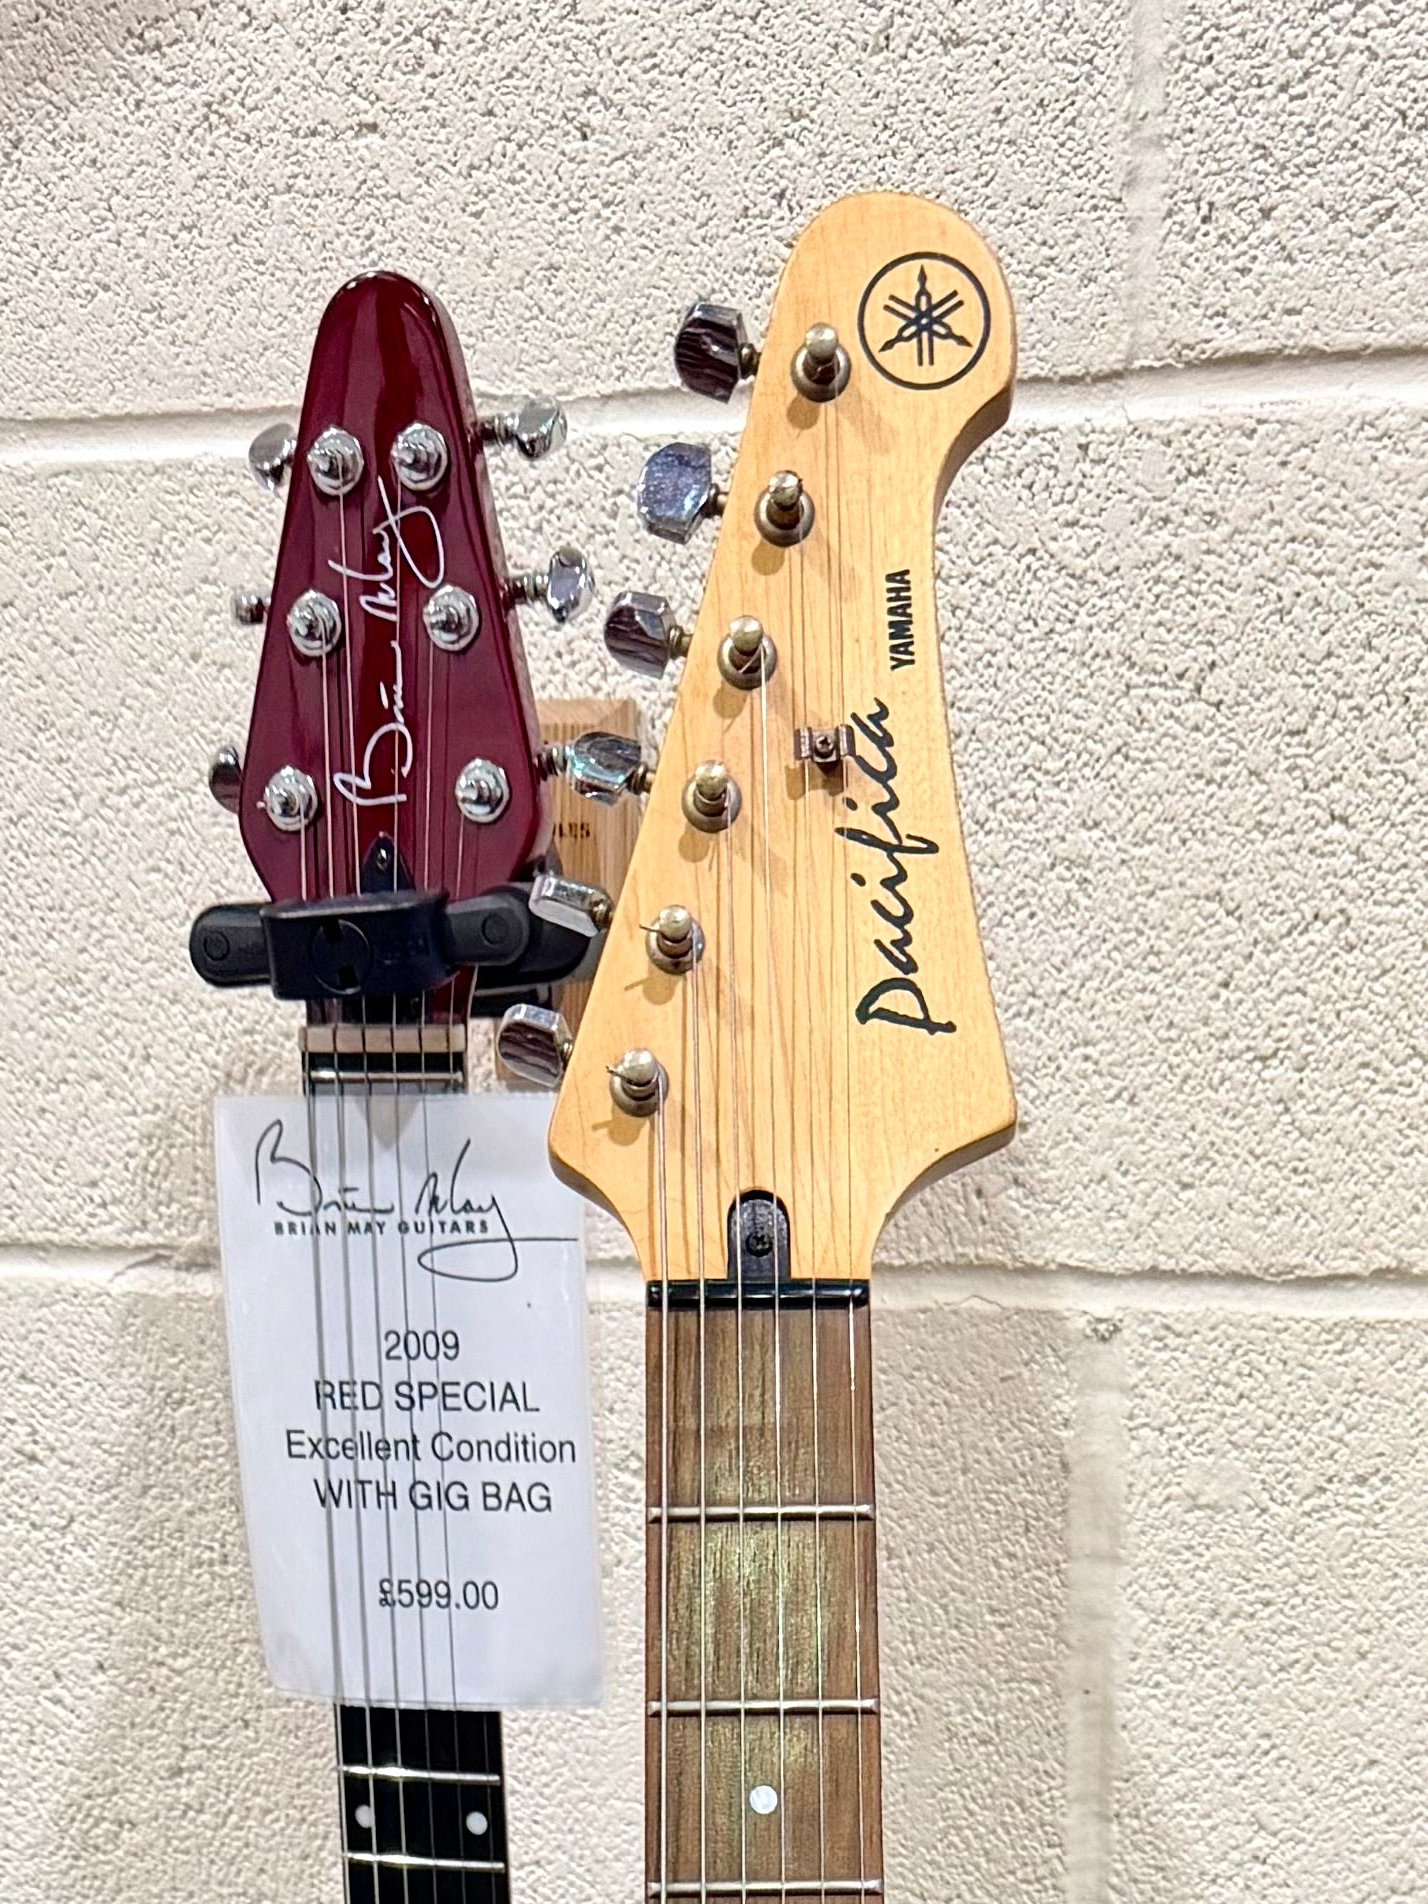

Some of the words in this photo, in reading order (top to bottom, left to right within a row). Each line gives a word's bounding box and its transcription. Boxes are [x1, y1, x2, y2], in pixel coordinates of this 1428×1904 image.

[885, 569, 915, 672] YAMAHA
[834, 697, 957, 1036] Pacifica
[274, 1220, 336, 1235] BRIAN
[348, 1220, 387, 1235] MAY
[398, 1220, 489, 1235] GUITARS
[383, 1330, 460, 1361] 2009
[315, 1379, 383, 1411] RED
[394, 1380, 540, 1412] SPECIAL
[285, 1429, 421, 1462] Excellent
[431, 1431, 577, 1463] Condition
[313, 1478, 397, 1511] WITH
[408, 1480, 470, 1511] GIG
[481, 1481, 552, 1513] BAG
[378, 1578, 500, 1610] £599.00
